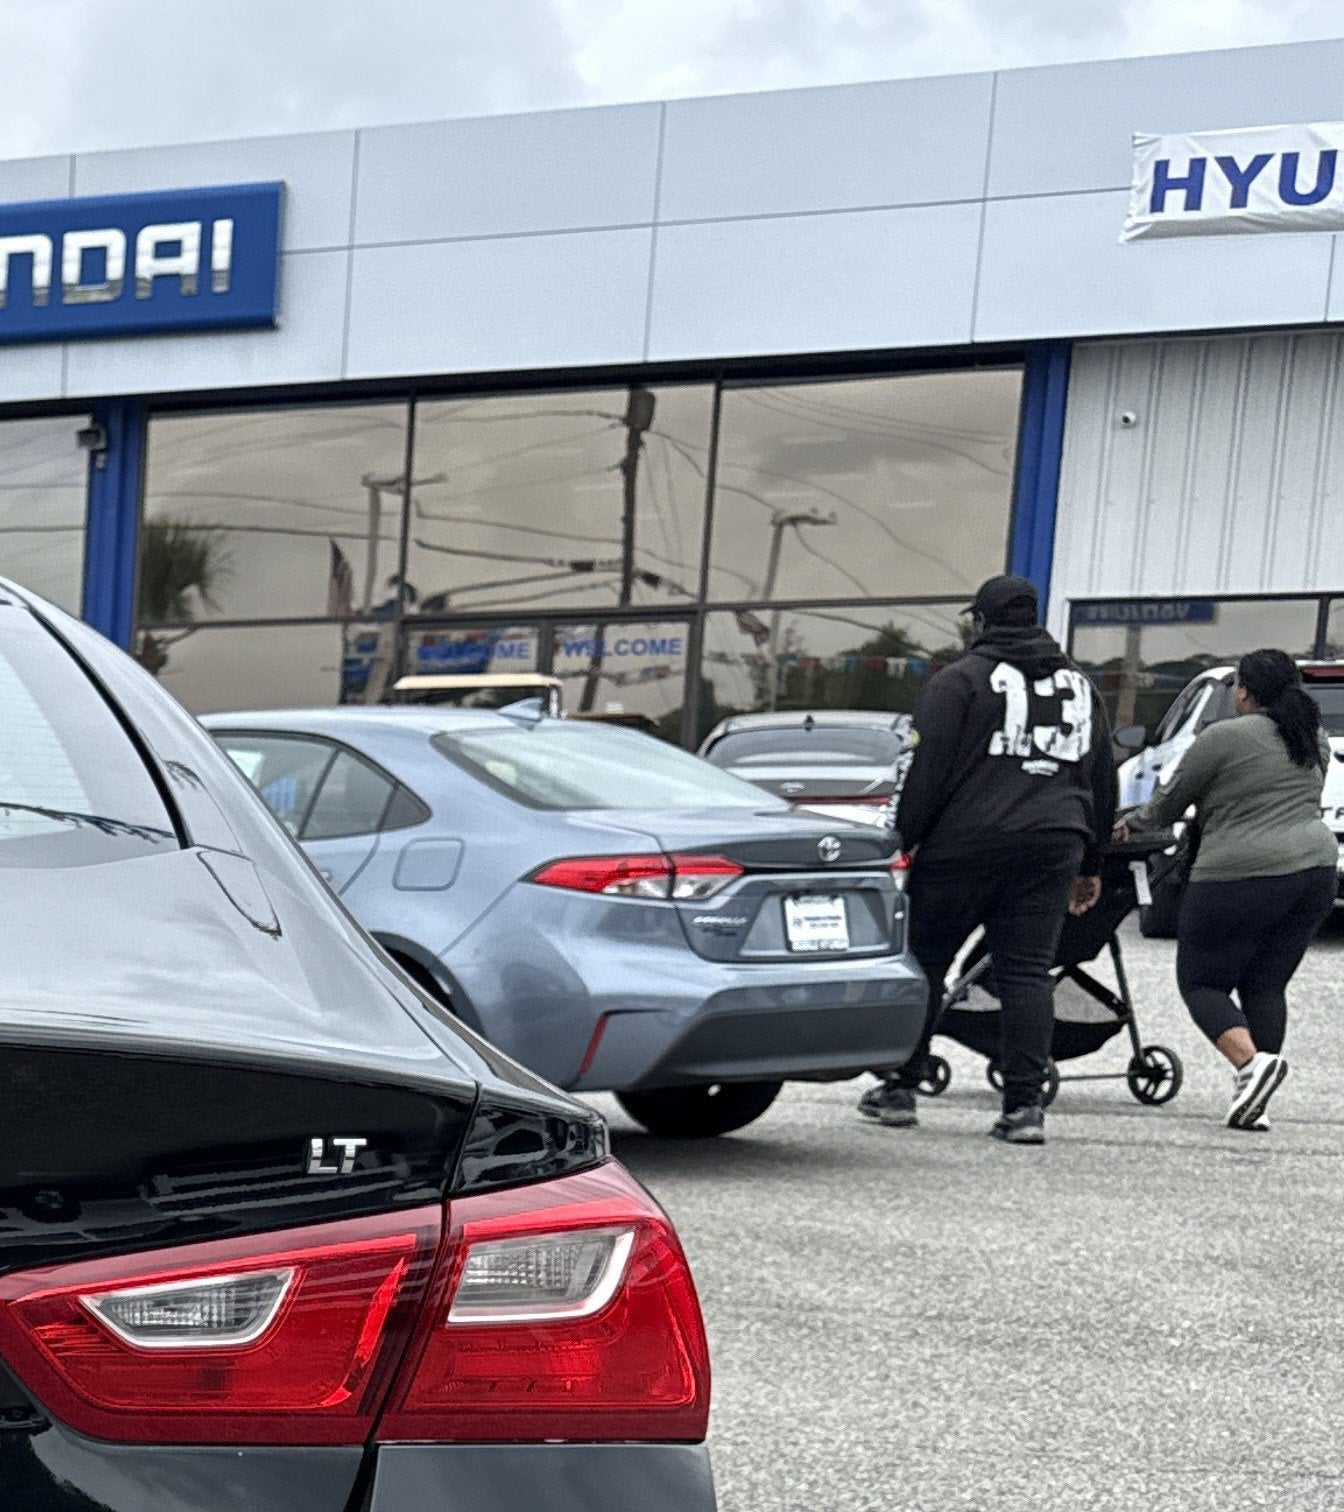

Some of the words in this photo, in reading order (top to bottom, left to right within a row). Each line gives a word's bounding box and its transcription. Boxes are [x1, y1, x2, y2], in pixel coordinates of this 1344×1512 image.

[1149, 149, 1339, 213] HYU
[988, 661, 1092, 762] 13
[308, 1138, 367, 1174] LT
